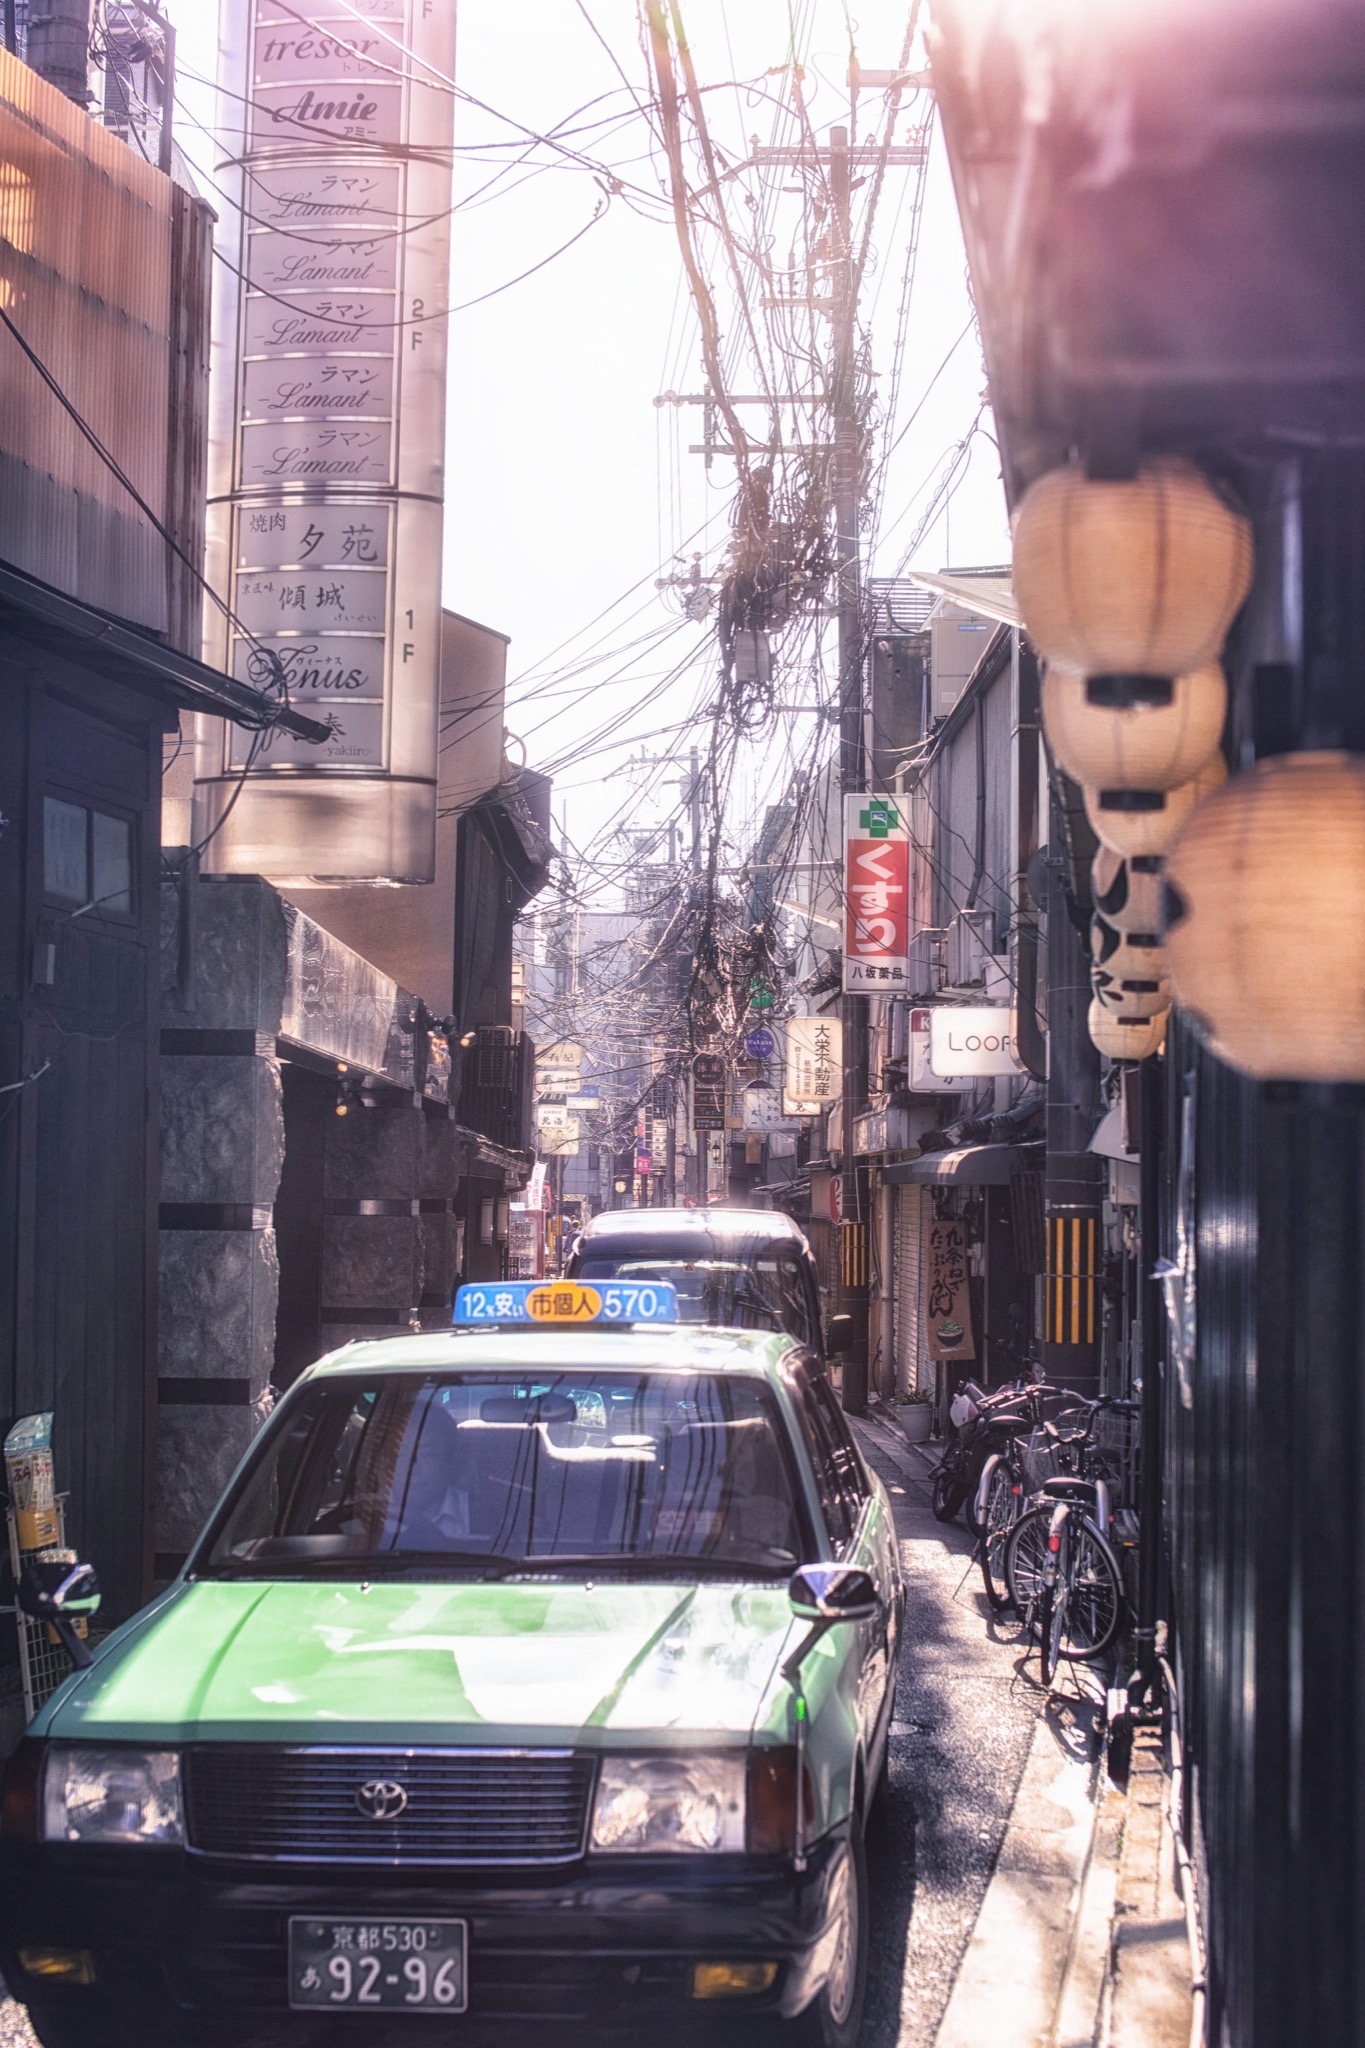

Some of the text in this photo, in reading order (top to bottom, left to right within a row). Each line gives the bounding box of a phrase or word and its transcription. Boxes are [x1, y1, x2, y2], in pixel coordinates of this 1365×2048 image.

[263, 31, 380, 62] trésor
[272, 90, 378, 123] Amie
[344, 126, 377, 138] アミー
[321, 175, 379, 192] ラマン
[325, 238, 384, 256] ラマン
[316, 302, 374, 319] ラマン
[321, 365, 380, 384] ラマン
[318, 430, 382, 448] ラマン
[250, 512, 286, 533] 焼肉
[298, 523, 379, 561] 夕苑
[279, 582, 345, 611] 傾城
[851, 966, 904, 981] 八坂薬品
[814, 1024, 831, 1096] 大栄不動産
[532, 1292, 594, 1317] 市個人
[301, 1955, 456, 2004] あ 92-96
